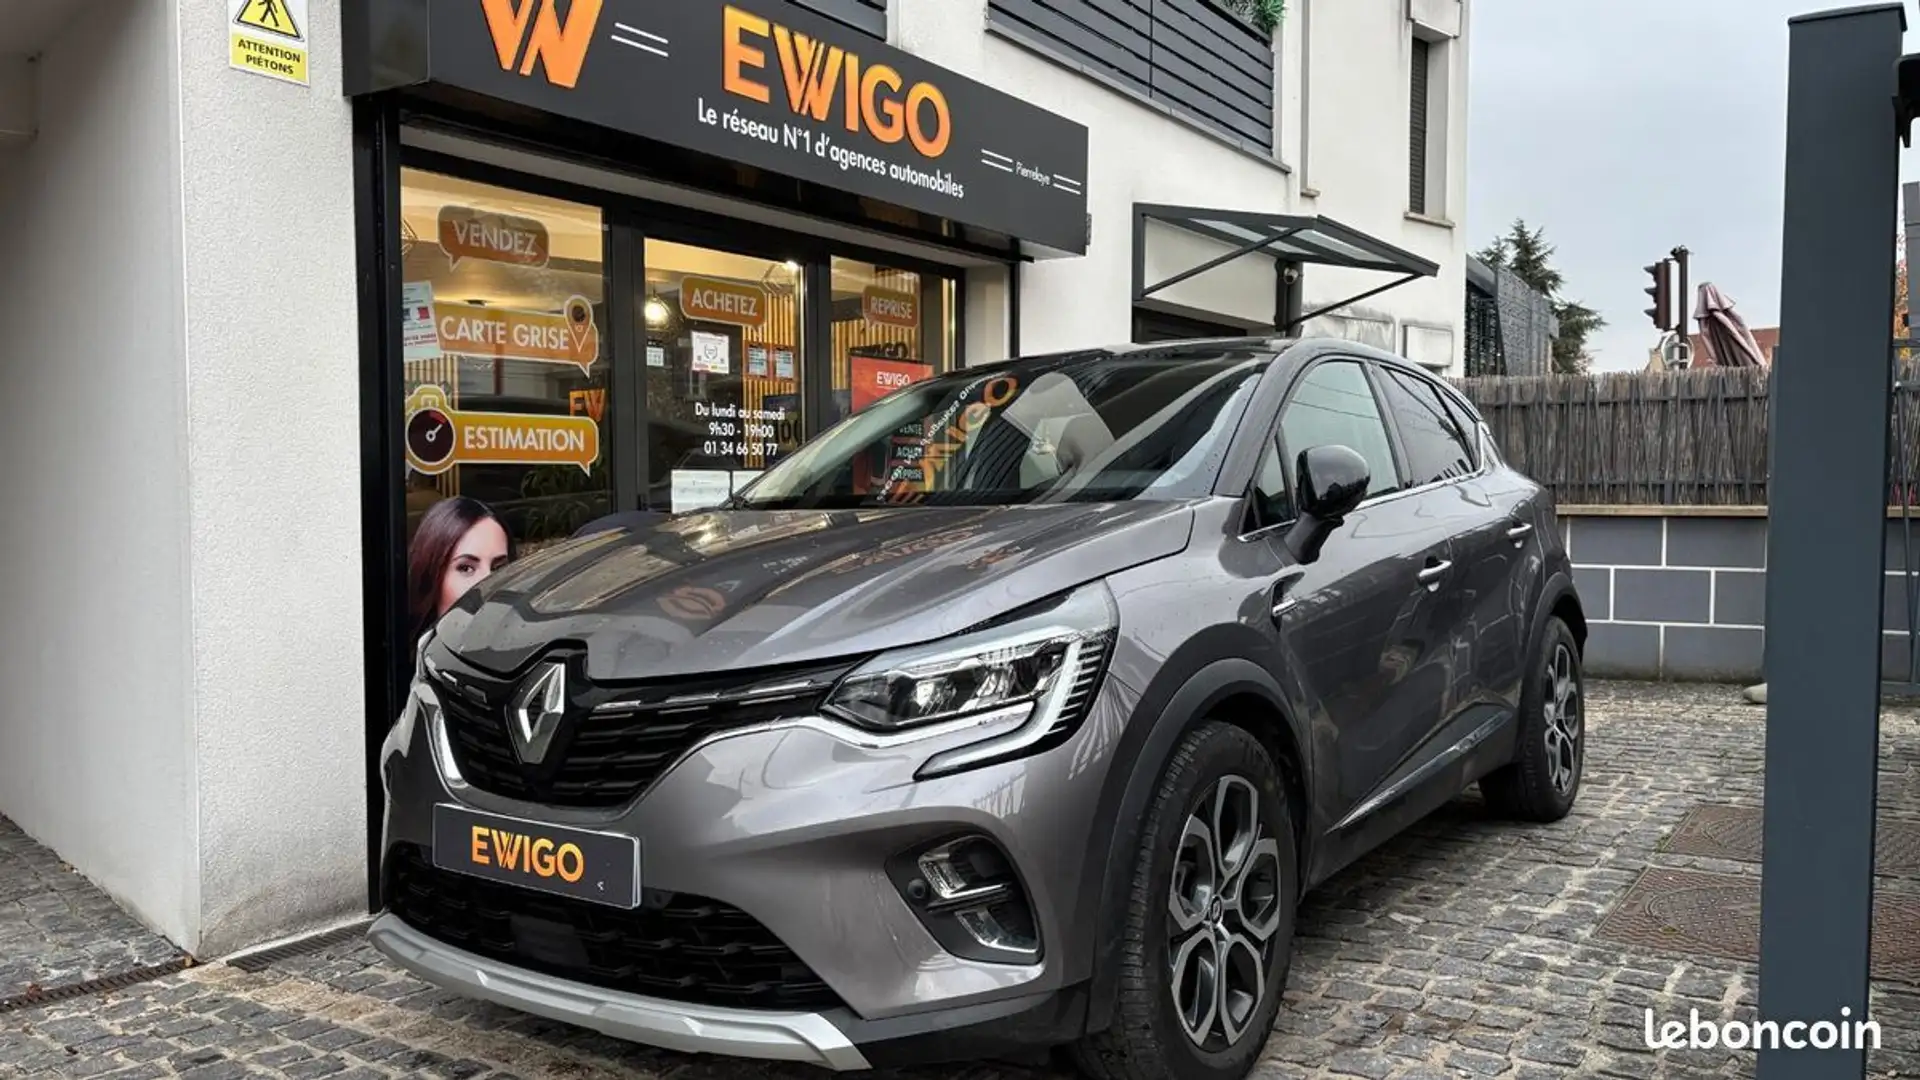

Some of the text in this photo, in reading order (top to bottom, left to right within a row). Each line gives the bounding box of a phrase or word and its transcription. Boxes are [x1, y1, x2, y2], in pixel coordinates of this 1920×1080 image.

[238, 39, 301, 63] ATTENTION
[246, 54, 294, 75] PIÉTONS
[723, 4, 951, 158] EWIGO
[698, 97, 717, 125] Le
[723, 108, 778, 144] réseau
[815, 133, 887, 176] d'agences
[890, 164, 965, 199] automobiles
[451, 219, 538, 257] VENDEZ
[691, 287, 758, 318] ACHETEZ
[871, 296, 913, 320] REPRISE
[440, 315, 507, 345] CARTE
[513, 324, 570, 351] GRISE
[876, 371, 910, 386] EWIGO
[695, 402, 786, 420] Du lundi au samedi
[464, 425, 585, 453] ESTIMATION
[708, 422, 735, 437] 9h30
[744, 422, 775, 438] 19h00
[704, 441, 779, 456] 01 34 66 50 77
[471, 825, 584, 882] EWIGO
